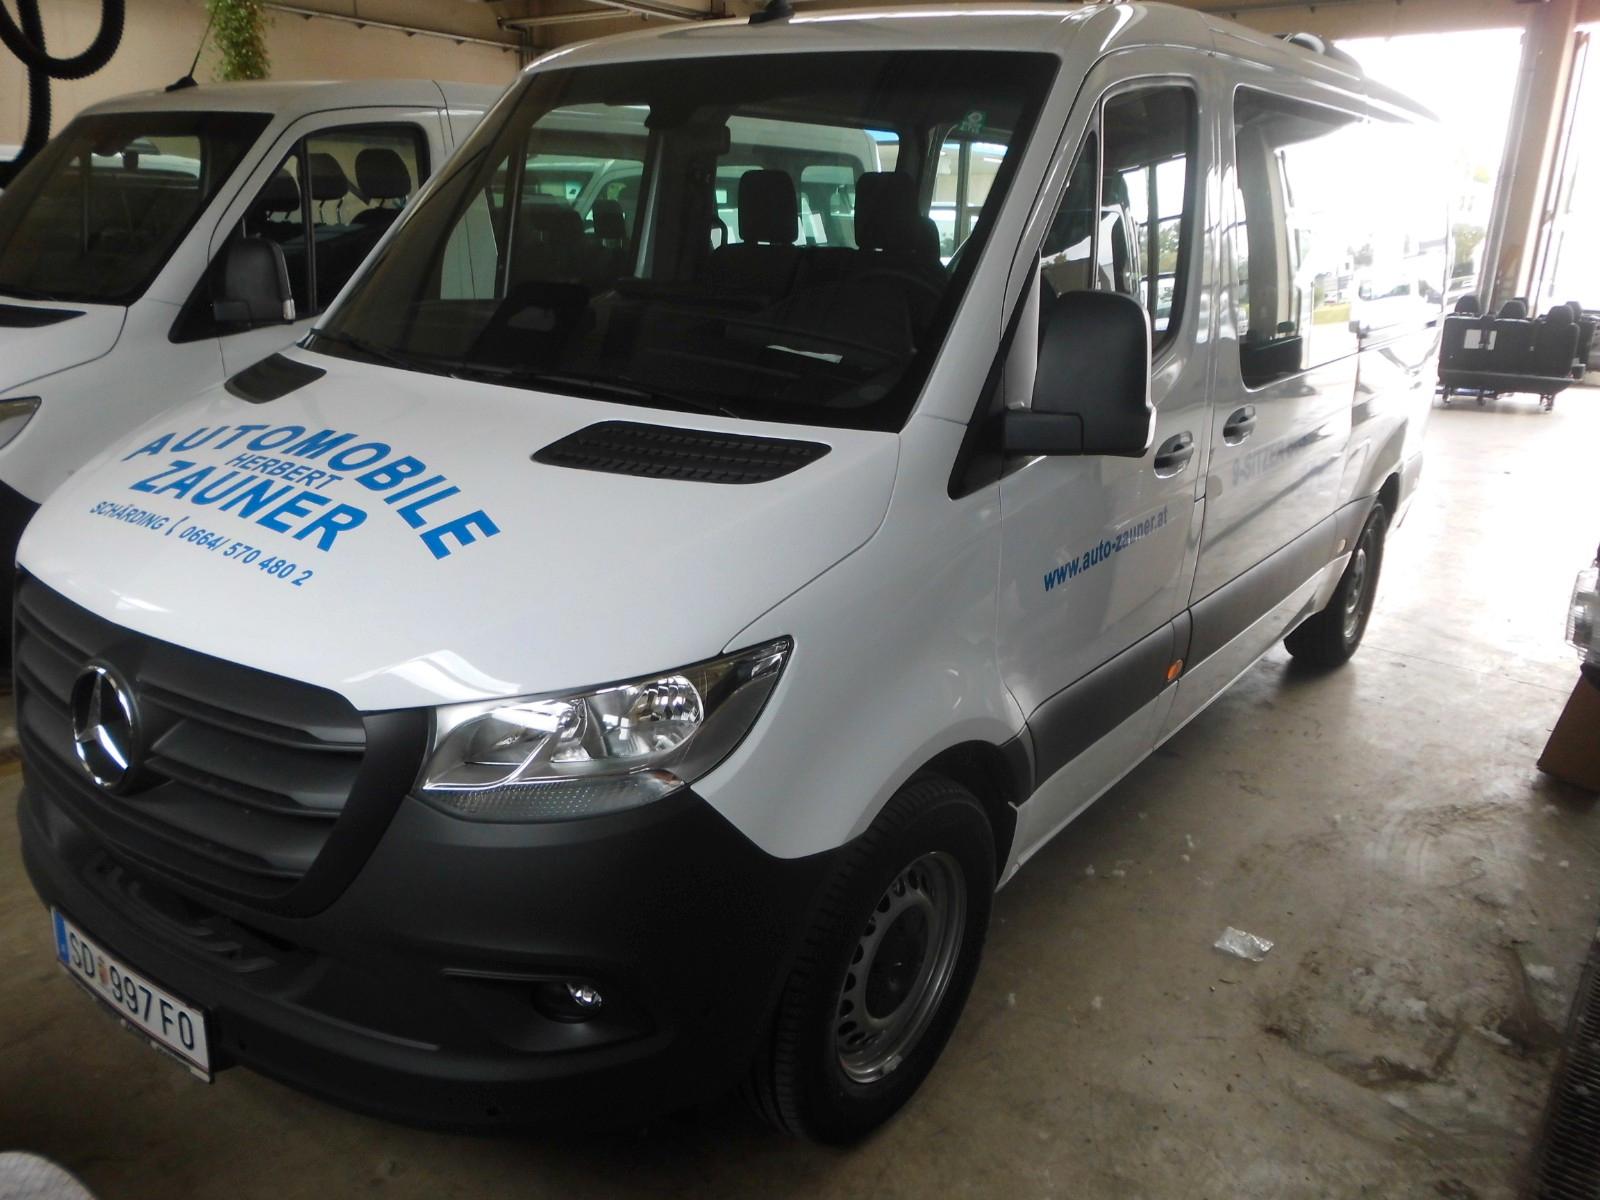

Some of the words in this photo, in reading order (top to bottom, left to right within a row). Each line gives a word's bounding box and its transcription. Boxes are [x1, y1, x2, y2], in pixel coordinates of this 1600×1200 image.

[121, 424, 501, 561] AUTOMOBILE
[128, 460, 368, 552] ZAUNER
[224, 453, 344, 489] HERBERT
[89, 501, 170, 530] SCHÄRDING
[178, 526, 231, 551] 0664/
[223, 542, 262, 564] 570
[258, 556, 297, 579] 480
[291, 570, 314, 587] 2
[1043, 505, 1169, 592] www.auto-zauner.at
[69, 932, 95, 978] SD
[109, 965, 152, 1022] 997
